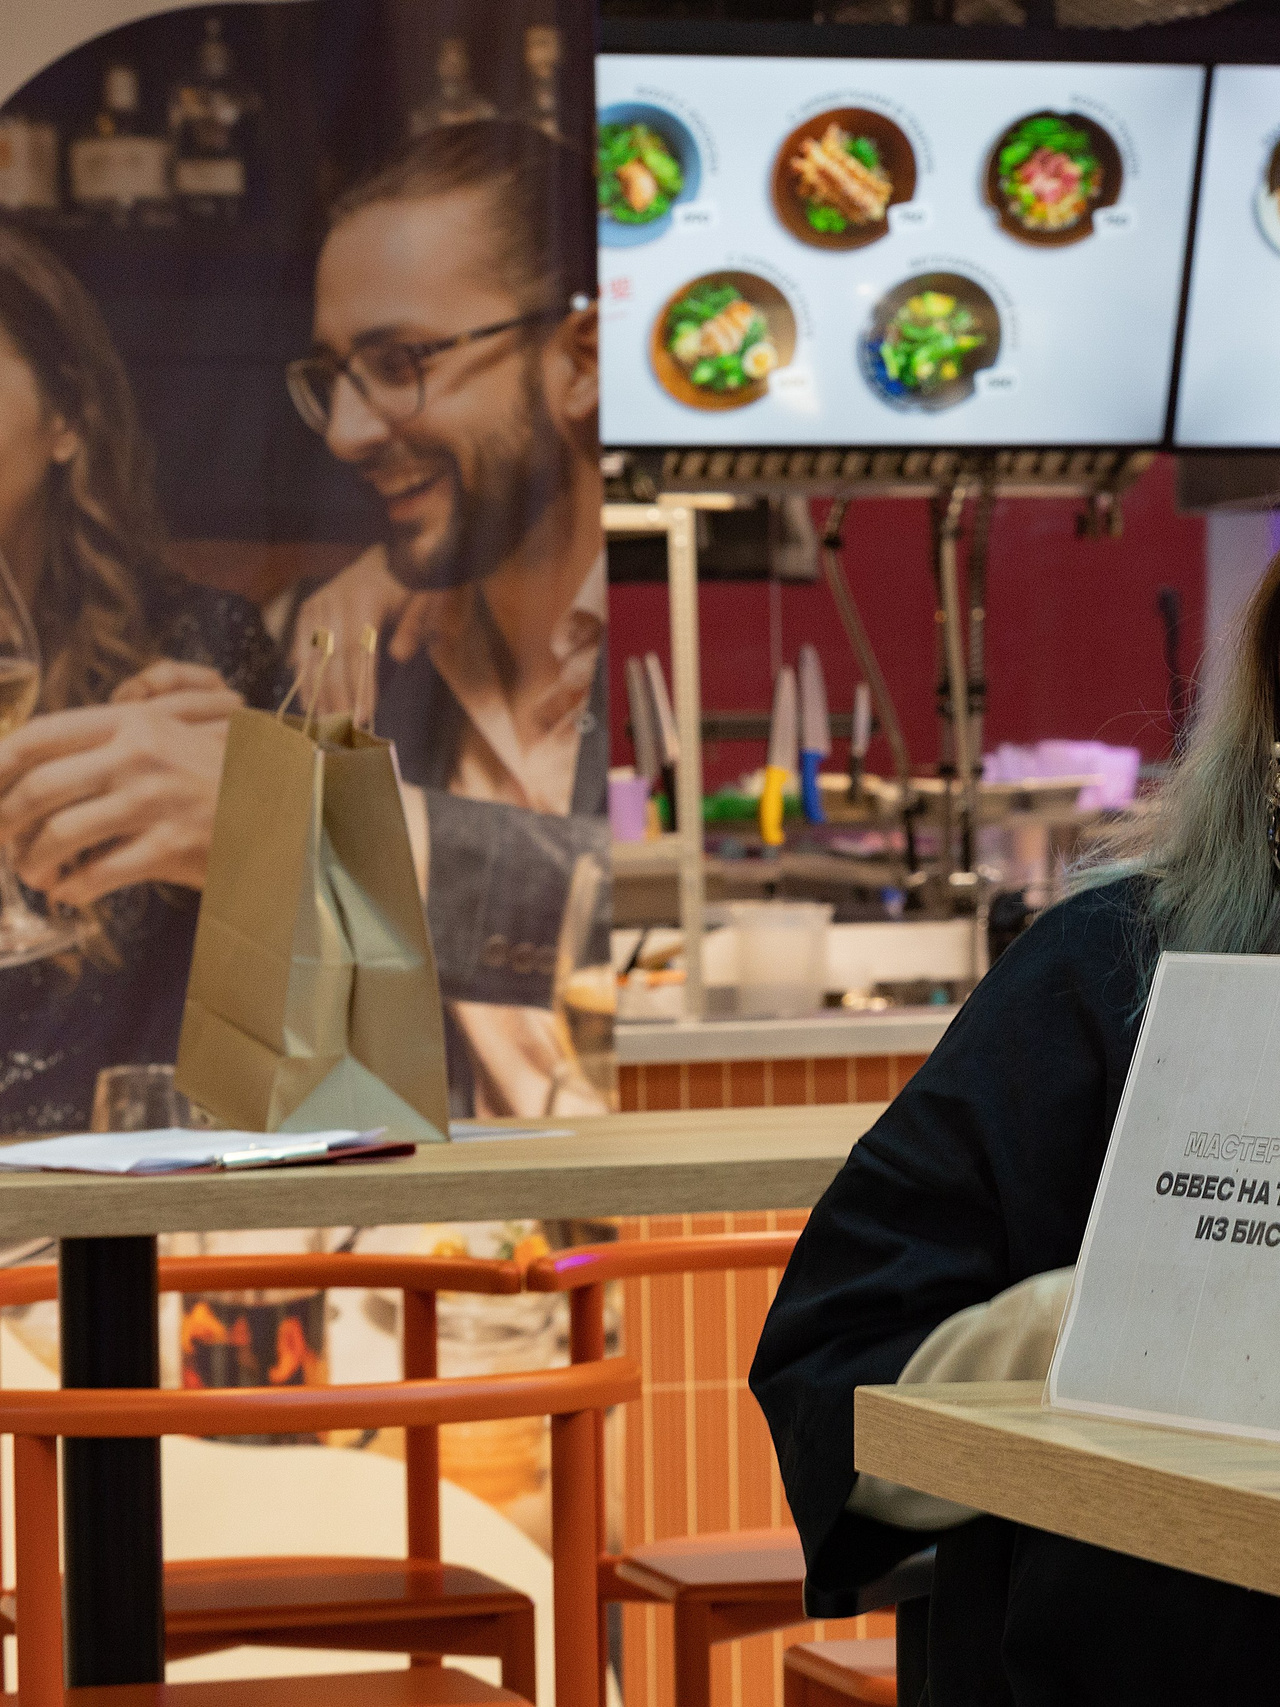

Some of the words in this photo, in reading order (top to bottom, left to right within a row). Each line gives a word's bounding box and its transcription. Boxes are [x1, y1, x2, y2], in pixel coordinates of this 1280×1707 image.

[1156, 1170, 1235, 1201] ОБВЕС
[1236, 1177, 1270, 1205] НА
[1194, 1214, 1229, 1241] ИЗ
